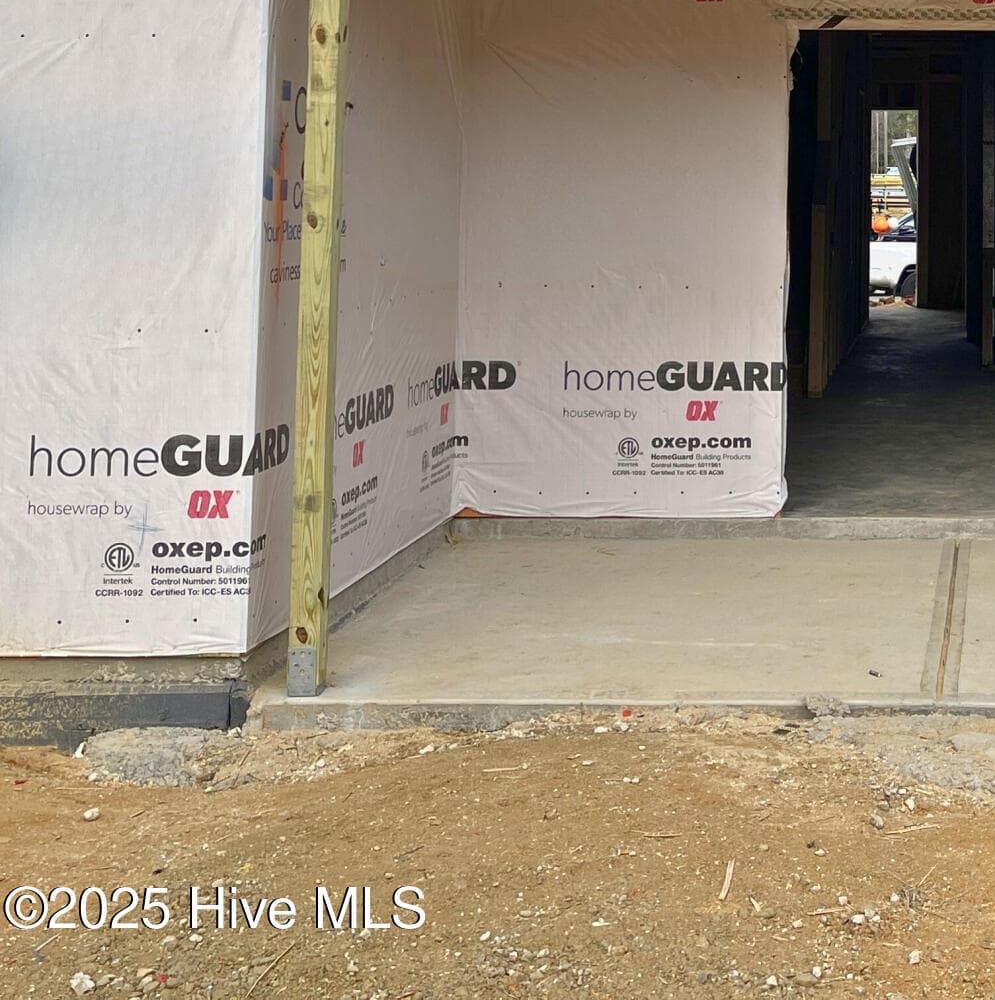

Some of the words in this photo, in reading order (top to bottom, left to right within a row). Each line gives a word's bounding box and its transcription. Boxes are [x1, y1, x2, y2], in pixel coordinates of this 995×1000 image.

[407, 360, 517, 410] homeGUARD
[564, 360, 788, 392] homeGUARD
[562, 407, 622, 419] housewrap
[624, 407, 638, 420] by
[686, 400, 719, 421] OX
[29, 423, 290, 477] homeGUARD
[651, 437, 752, 451] oxep.com
[27, 500, 110, 517] housewrap
[114, 500, 133, 518] by
[187, 490, 234, 519] OX
[152, 535, 267, 561] oxep.com
[151, 565, 213, 574] HomeGuard
[216, 565, 250, 575] Building
[103, 577, 133, 585] Intertek
[95, 589, 144, 597] CCRR-1092
[150, 588, 185, 596] Certified
[187, 588, 200, 596] To:
[201, 588, 232, 596] ICC-ES
